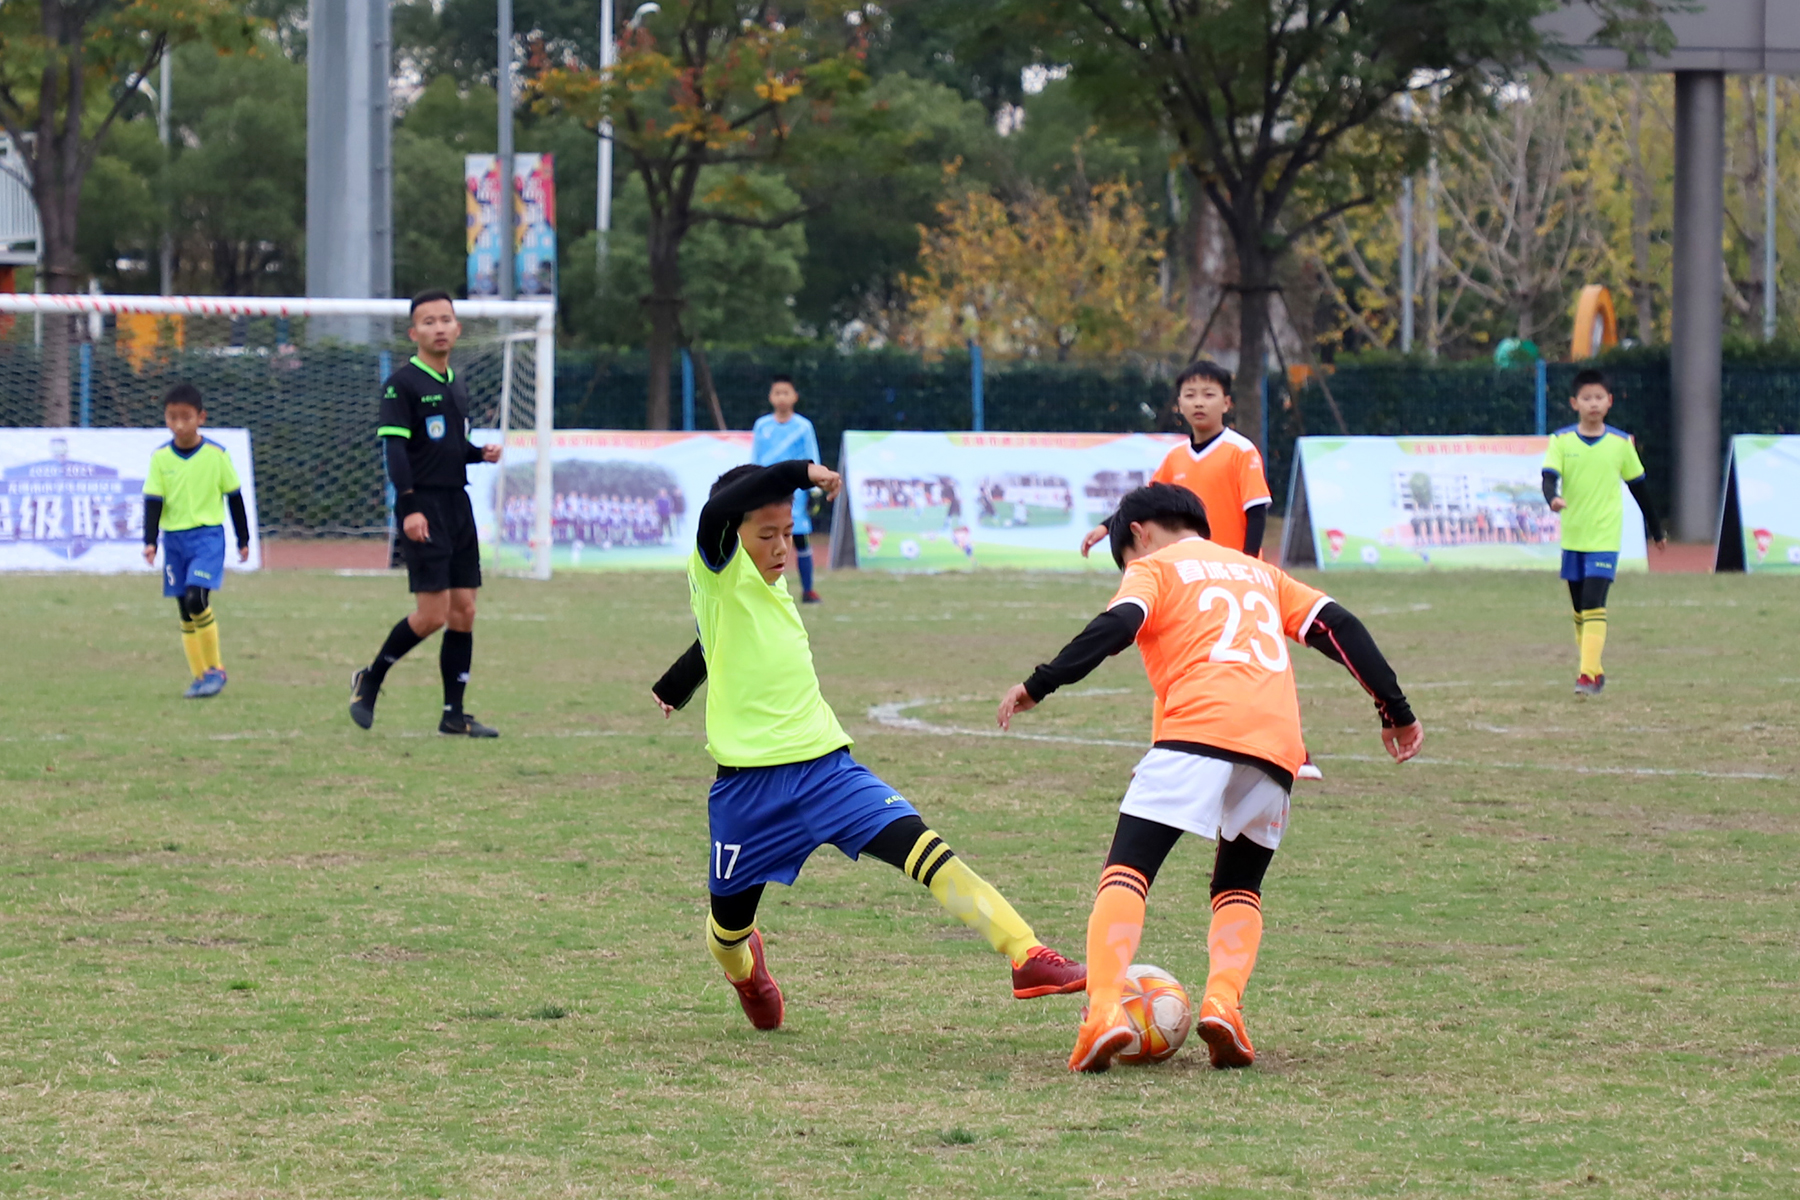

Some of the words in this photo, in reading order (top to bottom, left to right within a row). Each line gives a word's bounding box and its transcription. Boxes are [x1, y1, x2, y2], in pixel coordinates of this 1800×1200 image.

[1174, 559, 1275, 591] 春城实小
[1198, 586, 1288, 672] 23
[714, 840, 742, 880] 17
